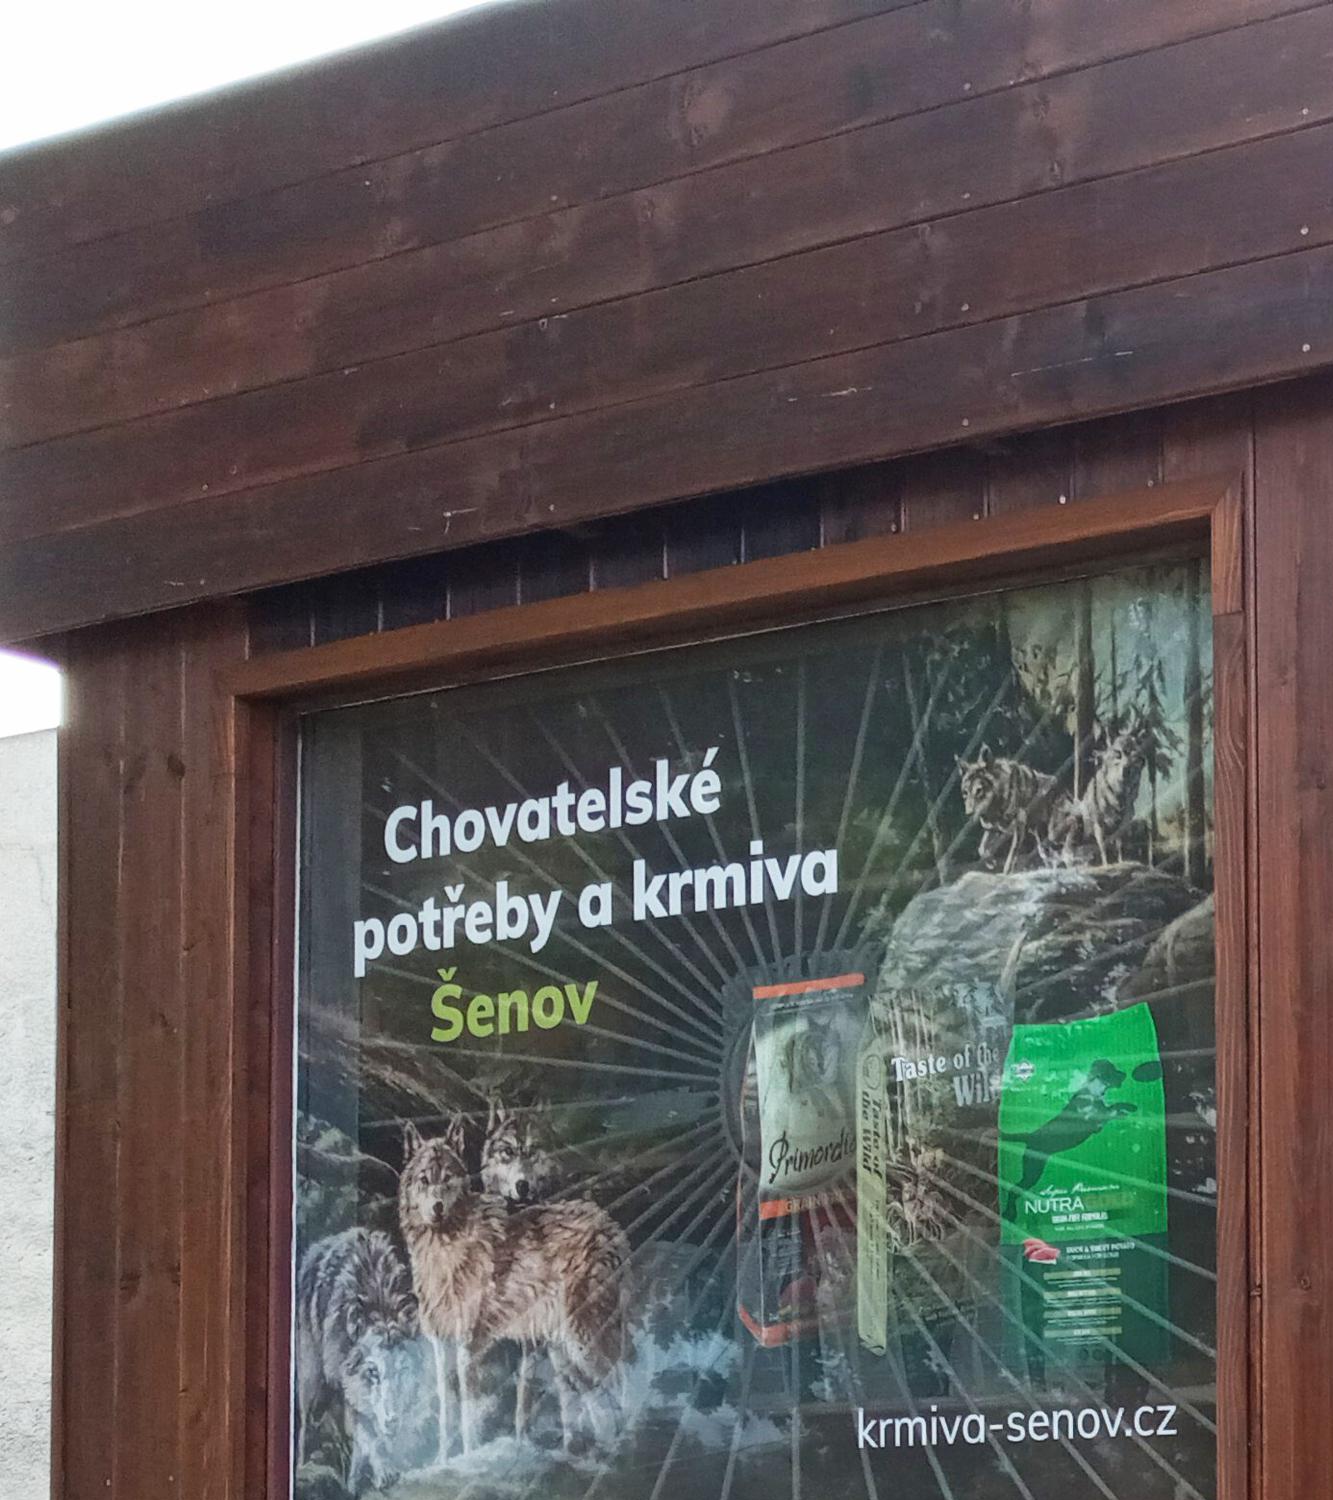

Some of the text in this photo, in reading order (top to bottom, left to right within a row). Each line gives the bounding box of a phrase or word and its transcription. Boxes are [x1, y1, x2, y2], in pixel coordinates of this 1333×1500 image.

[384, 747, 723, 864] Chovatelské
[353, 840, 838, 978] potřeby a krmiva
[430, 966, 598, 1044] Šenov
[891, 1054, 947, 1082] Taste
[953, 1043, 973, 1070] of
[1024, 1196, 1085, 1214] NUTRA
[856, 1403, 1179, 1451] krmiva-senov.cz
